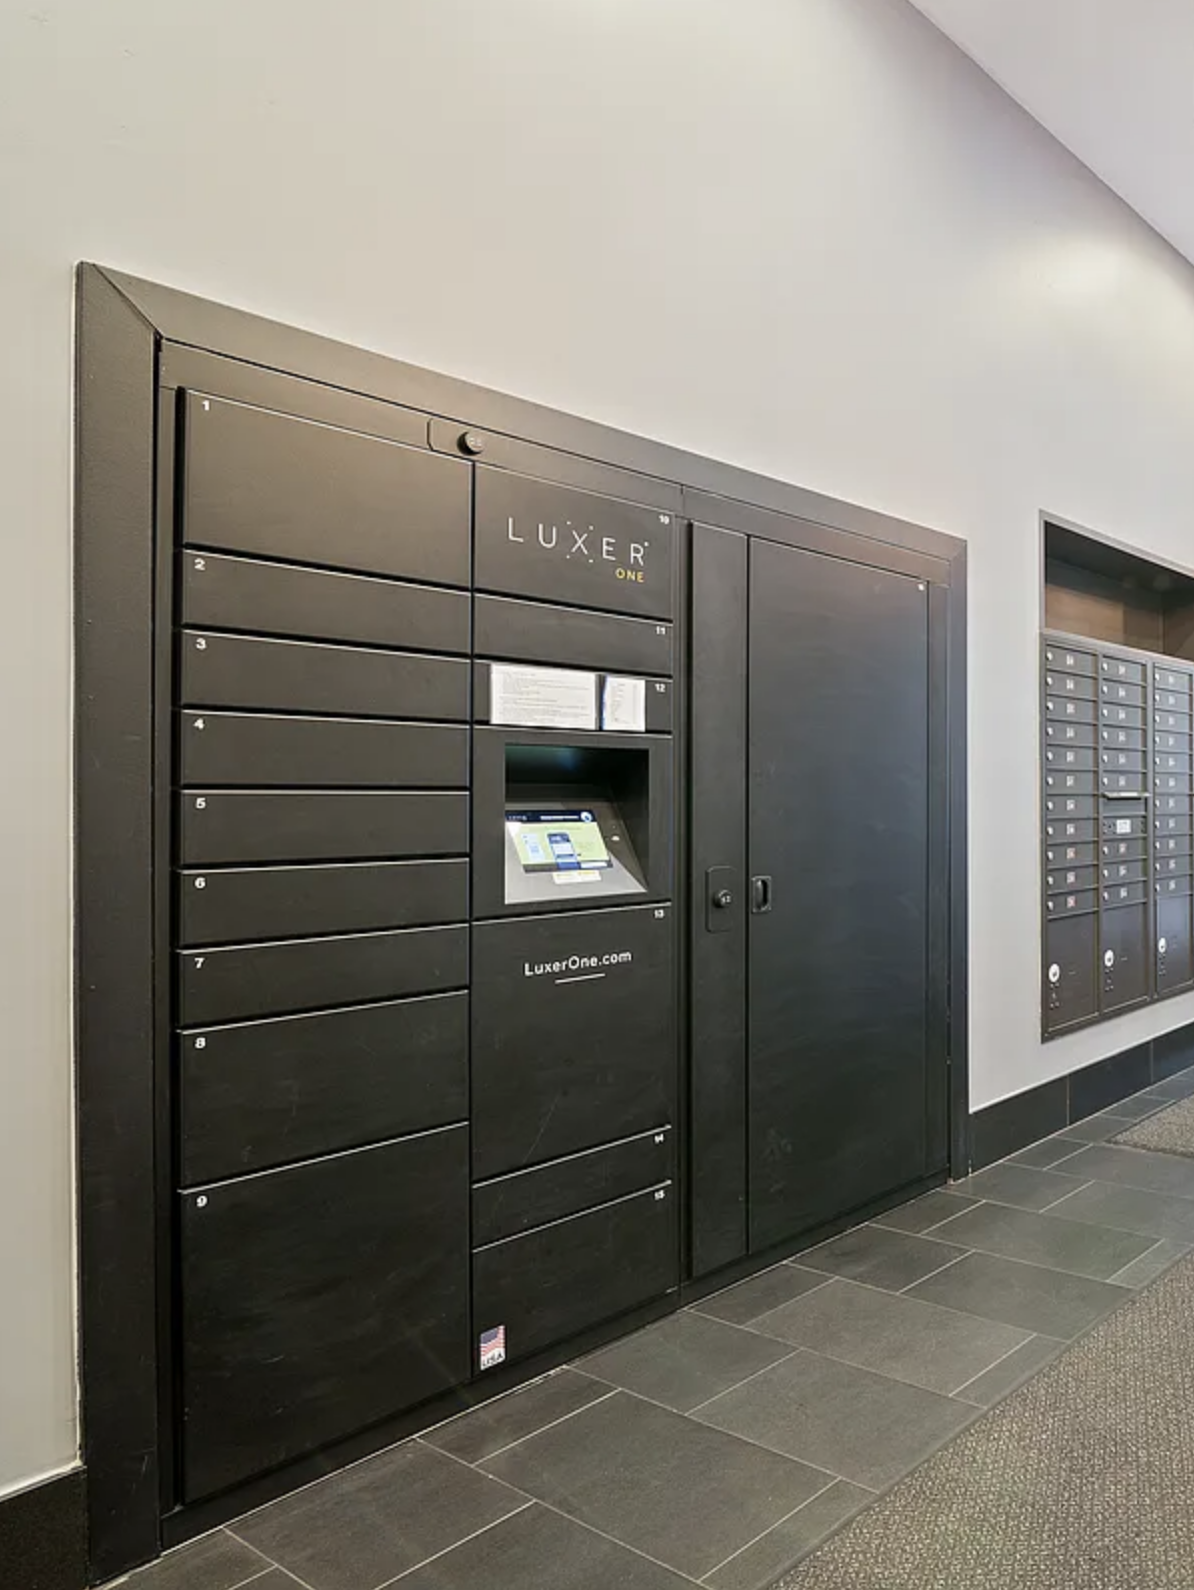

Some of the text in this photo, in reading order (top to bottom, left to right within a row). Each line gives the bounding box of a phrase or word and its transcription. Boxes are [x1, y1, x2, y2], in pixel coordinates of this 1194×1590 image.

[203, 399, 210, 411] 1
[508, 516, 649, 567] LUXER
[194, 558, 206, 571] 2
[615, 567, 645, 583] ONE
[195, 637, 206, 650] 3
[655, 683, 666, 693] 12
[194, 717, 205, 730] 4
[195, 797, 206, 809] 5
[194, 877, 206, 889] 6
[194, 957, 204, 969] 7
[524, 951, 632, 976] LuxerOne.com
[194, 1037, 206, 1049] 8
[196, 1195, 207, 1207] 9
